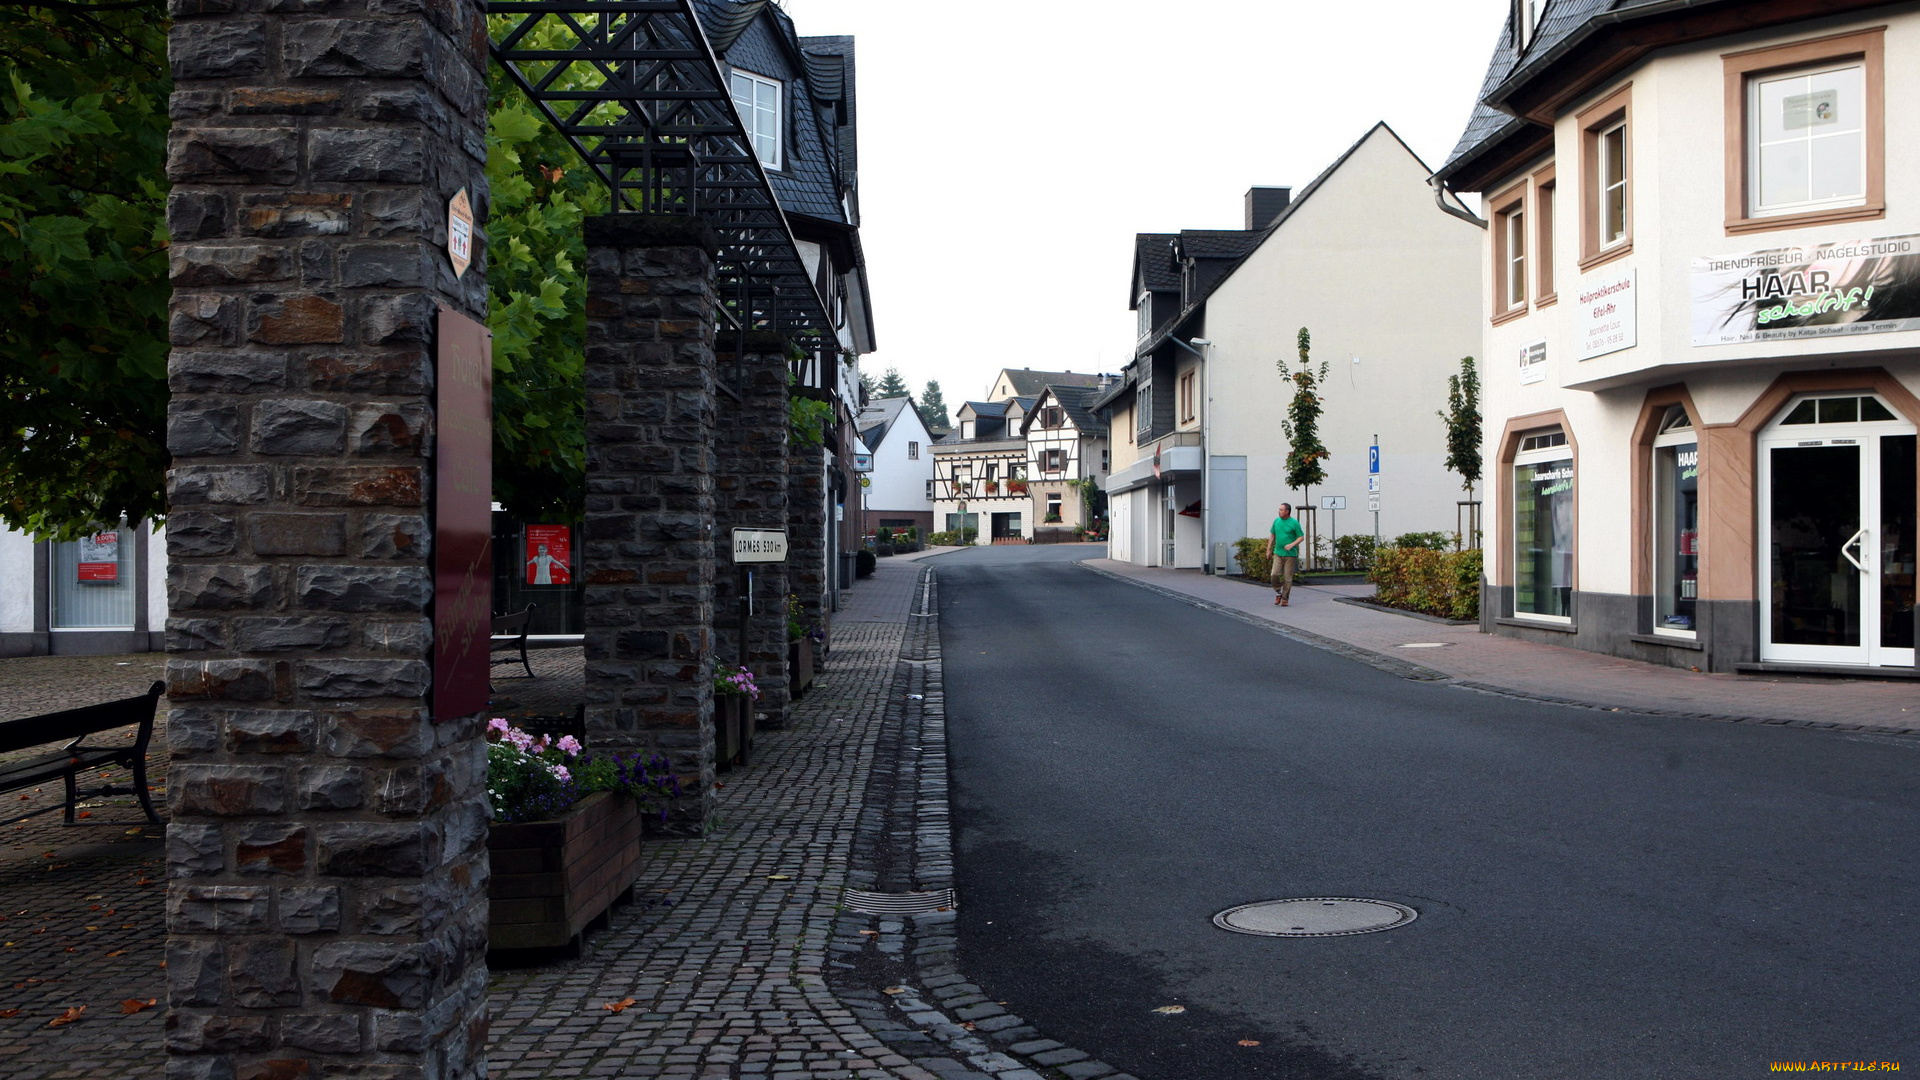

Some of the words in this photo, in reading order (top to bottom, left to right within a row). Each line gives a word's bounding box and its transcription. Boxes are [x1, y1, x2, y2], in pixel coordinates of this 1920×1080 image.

[1708, 252, 1803, 272] TRENDFRISEUR
[1816, 241, 1911, 260] NAGELSTUDIO
[1579, 277, 1631, 305] Heilpraktikerschule
[1741, 270, 1831, 300] HAAR
[1762, 331, 1787, 341] Beauty
[1788, 329, 1796, 339] by
[1798, 328, 1817, 338] Katja
[1851, 324, 1869, 333] ohne
[1871, 322, 1898, 332] Termin
[452, 342, 482, 389] Hotel
[1370, 449, 1377, 471] P
[735, 540, 760, 553] LORMES
